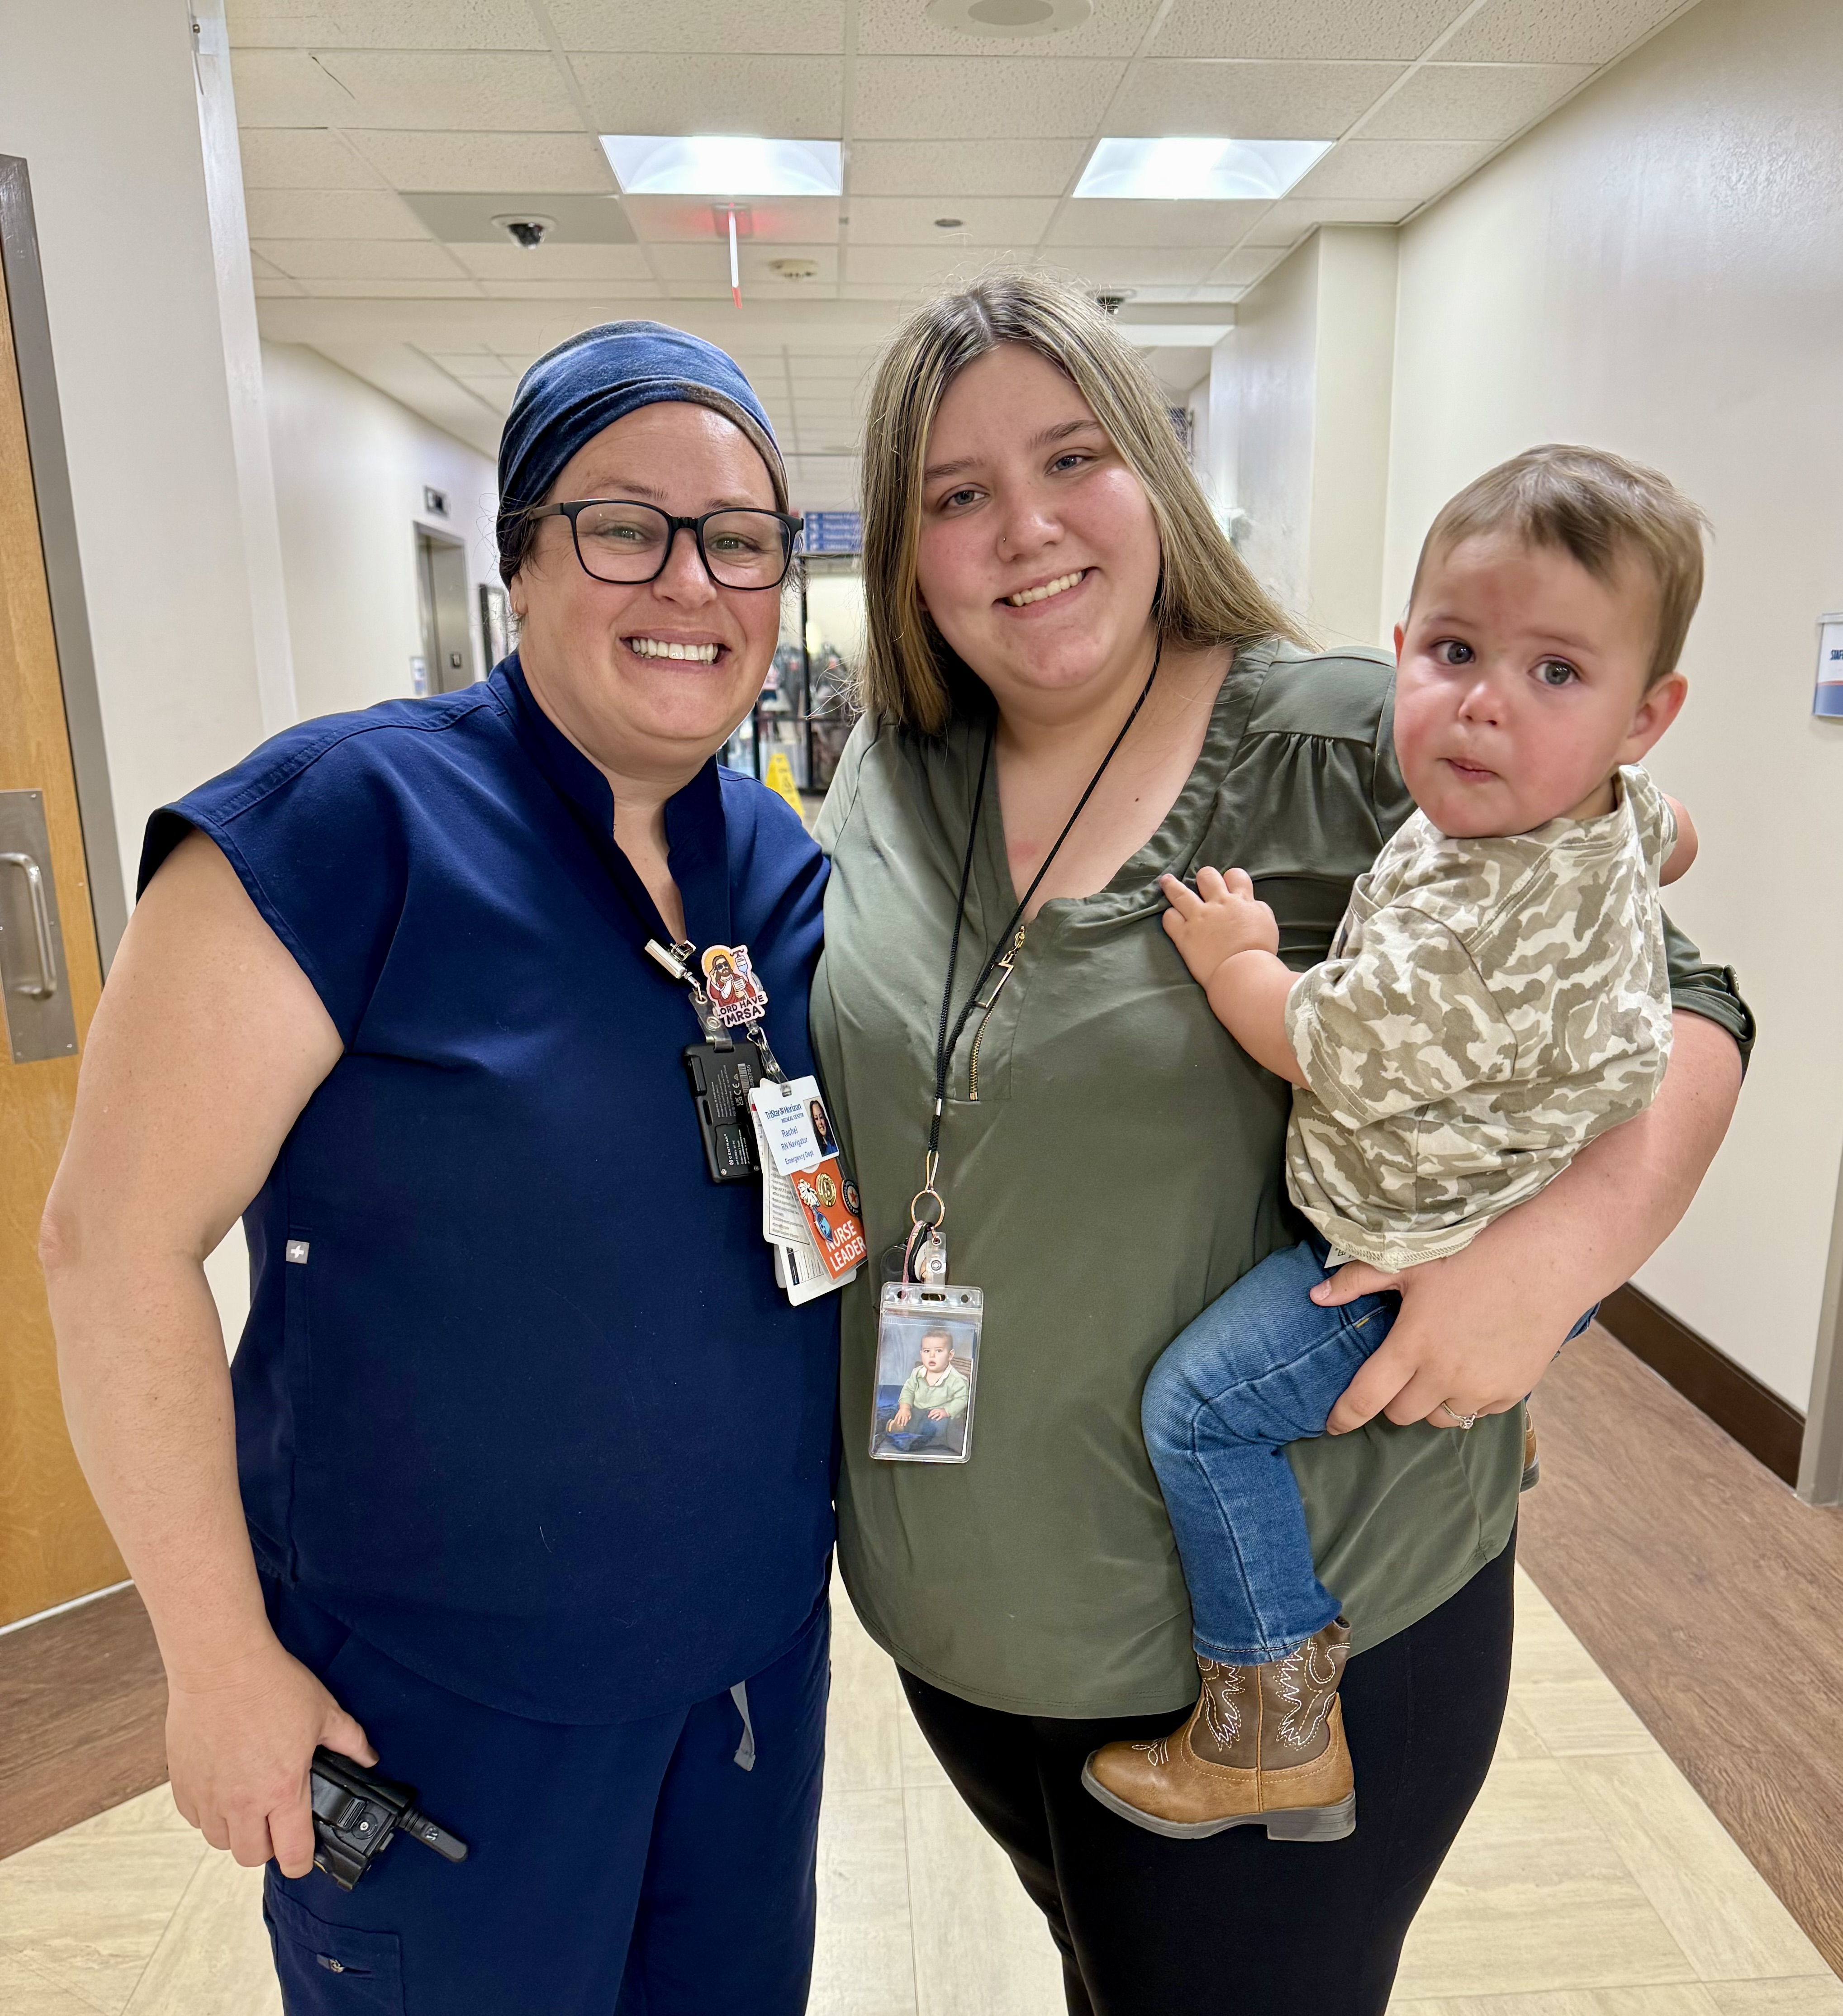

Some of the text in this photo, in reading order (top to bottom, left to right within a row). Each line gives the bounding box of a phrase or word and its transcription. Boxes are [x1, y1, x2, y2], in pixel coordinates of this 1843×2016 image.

[718, 995, 764, 1016] ORD HAVE
[726, 1006, 761, 1025] MRSA
[765, 1104, 802, 1119] TriStar Horizon
[781, 1126, 798, 1138] Rachel
[781, 1137, 808, 1151] RN Navigator
[825, 1220, 857, 1253] NURSE
[829, 1236, 867, 1272] LEADER
